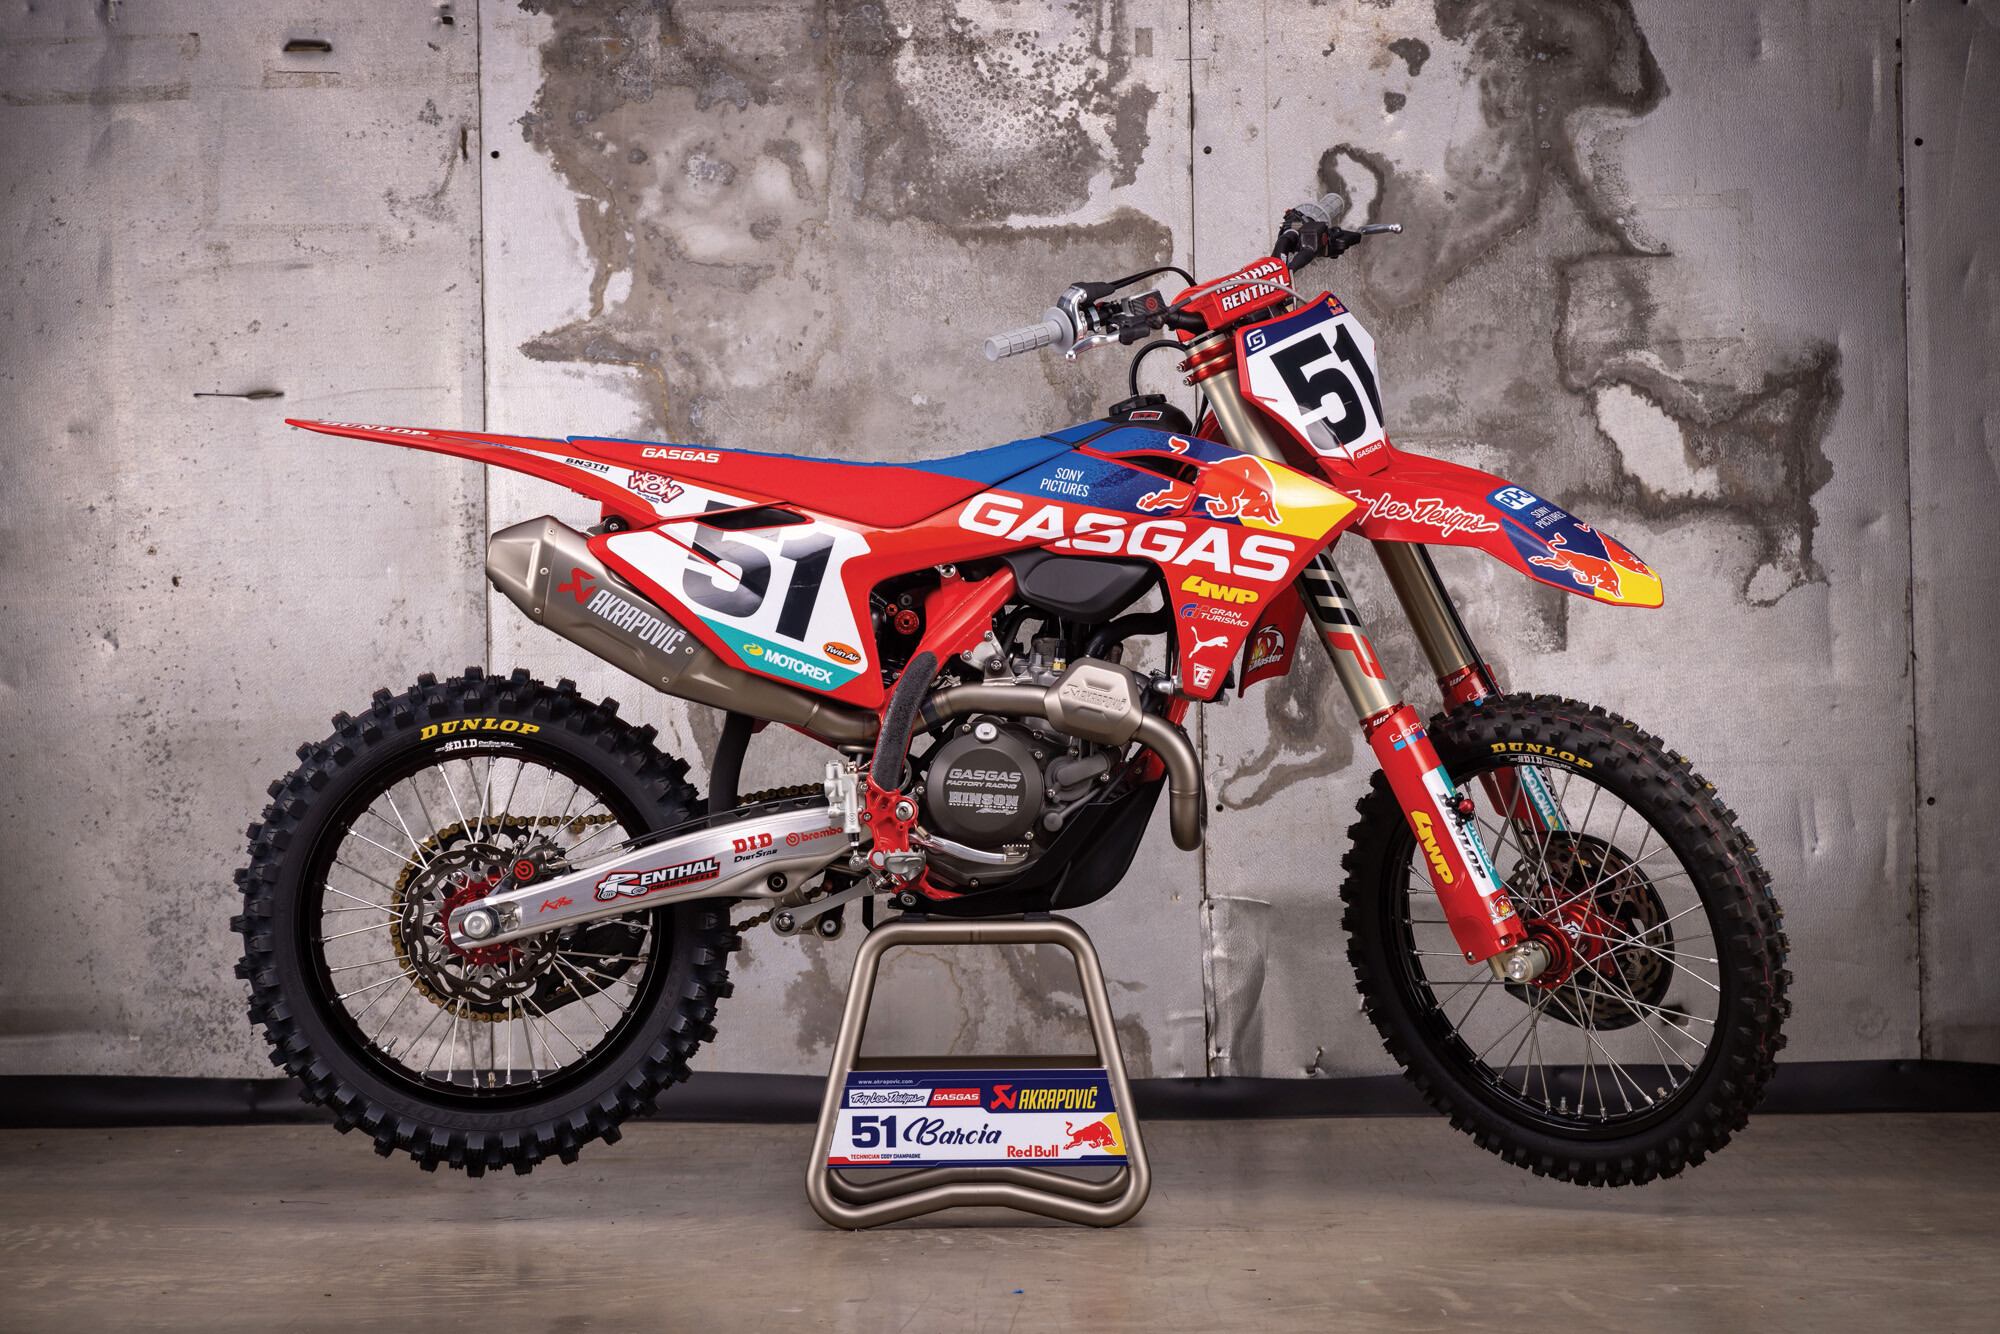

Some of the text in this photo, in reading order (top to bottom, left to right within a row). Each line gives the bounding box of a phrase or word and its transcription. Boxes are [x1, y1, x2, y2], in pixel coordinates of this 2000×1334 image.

[1221, 274, 1290, 312] RENTHAL
[1269, 323, 1384, 451] 51
[321, 421, 430, 436] DUNLOP
[642, 447, 720, 464] GASGAS
[1356, 442, 1382, 459] GASGAS
[634, 470, 673, 486] WOW
[1055, 467, 1084, 483] SONY
[1040, 478, 1090, 498] PICTURES
[1372, 492, 1412, 520] Lee
[1411, 498, 1499, 538] Designs
[1530, 506, 1551, 519] SONY
[1535, 511, 1567, 529] PICTURES
[958, 492, 1296, 582] GASGAS
[683, 500, 836, 642] 51
[1200, 612, 1249, 628] TURISMO
[1209, 607, 1242, 619] GRAN
[825, 644, 861, 662] Twin Air
[764, 649, 833, 684] MOTOREX
[420, 718, 540, 741] DUNLOP
[1491, 742, 1594, 769] DUNLOP
[948, 768, 1022, 783] GASGAS
[948, 791, 1020, 807] HINSON
[732, 832, 773, 854] D.I.D
[801, 826, 844, 842] brembo
[598, 858, 718, 899] RENTHAL
[650, 871, 718, 891] CHAINWHEELS
[851, 1091, 926, 1105] Troy Lee Designs
[933, 1093, 979, 1101] GASGAS
[852, 1115, 897, 1149] 51
[903, 1117, 1002, 1146] Barcia
[1007, 1145, 1059, 1158] Red Bull
